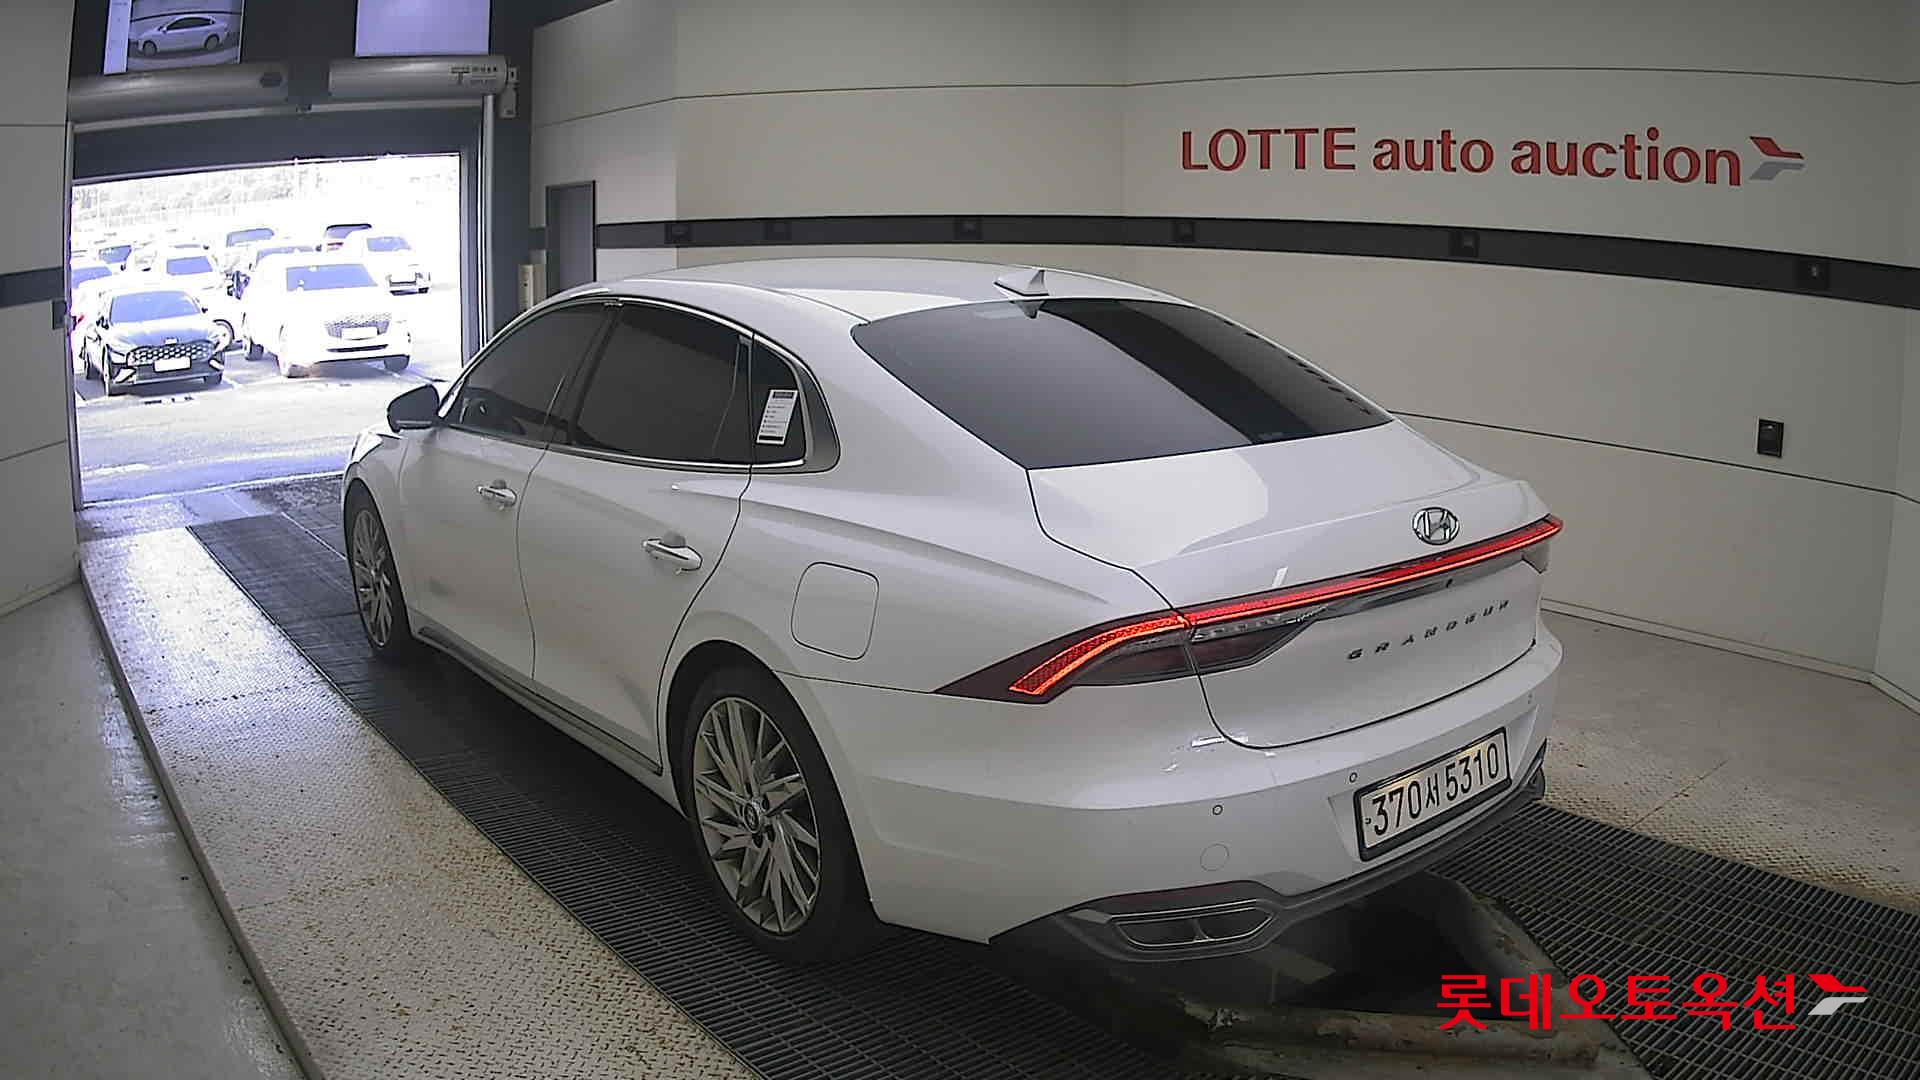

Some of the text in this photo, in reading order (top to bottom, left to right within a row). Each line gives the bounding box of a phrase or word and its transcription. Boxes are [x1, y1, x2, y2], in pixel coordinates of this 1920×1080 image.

[1182, 126, 1741, 186] LOTTE auto auction
[1347, 600, 1509, 660] GRANDEUR
[1445, 742, 1499, 801] 5310
